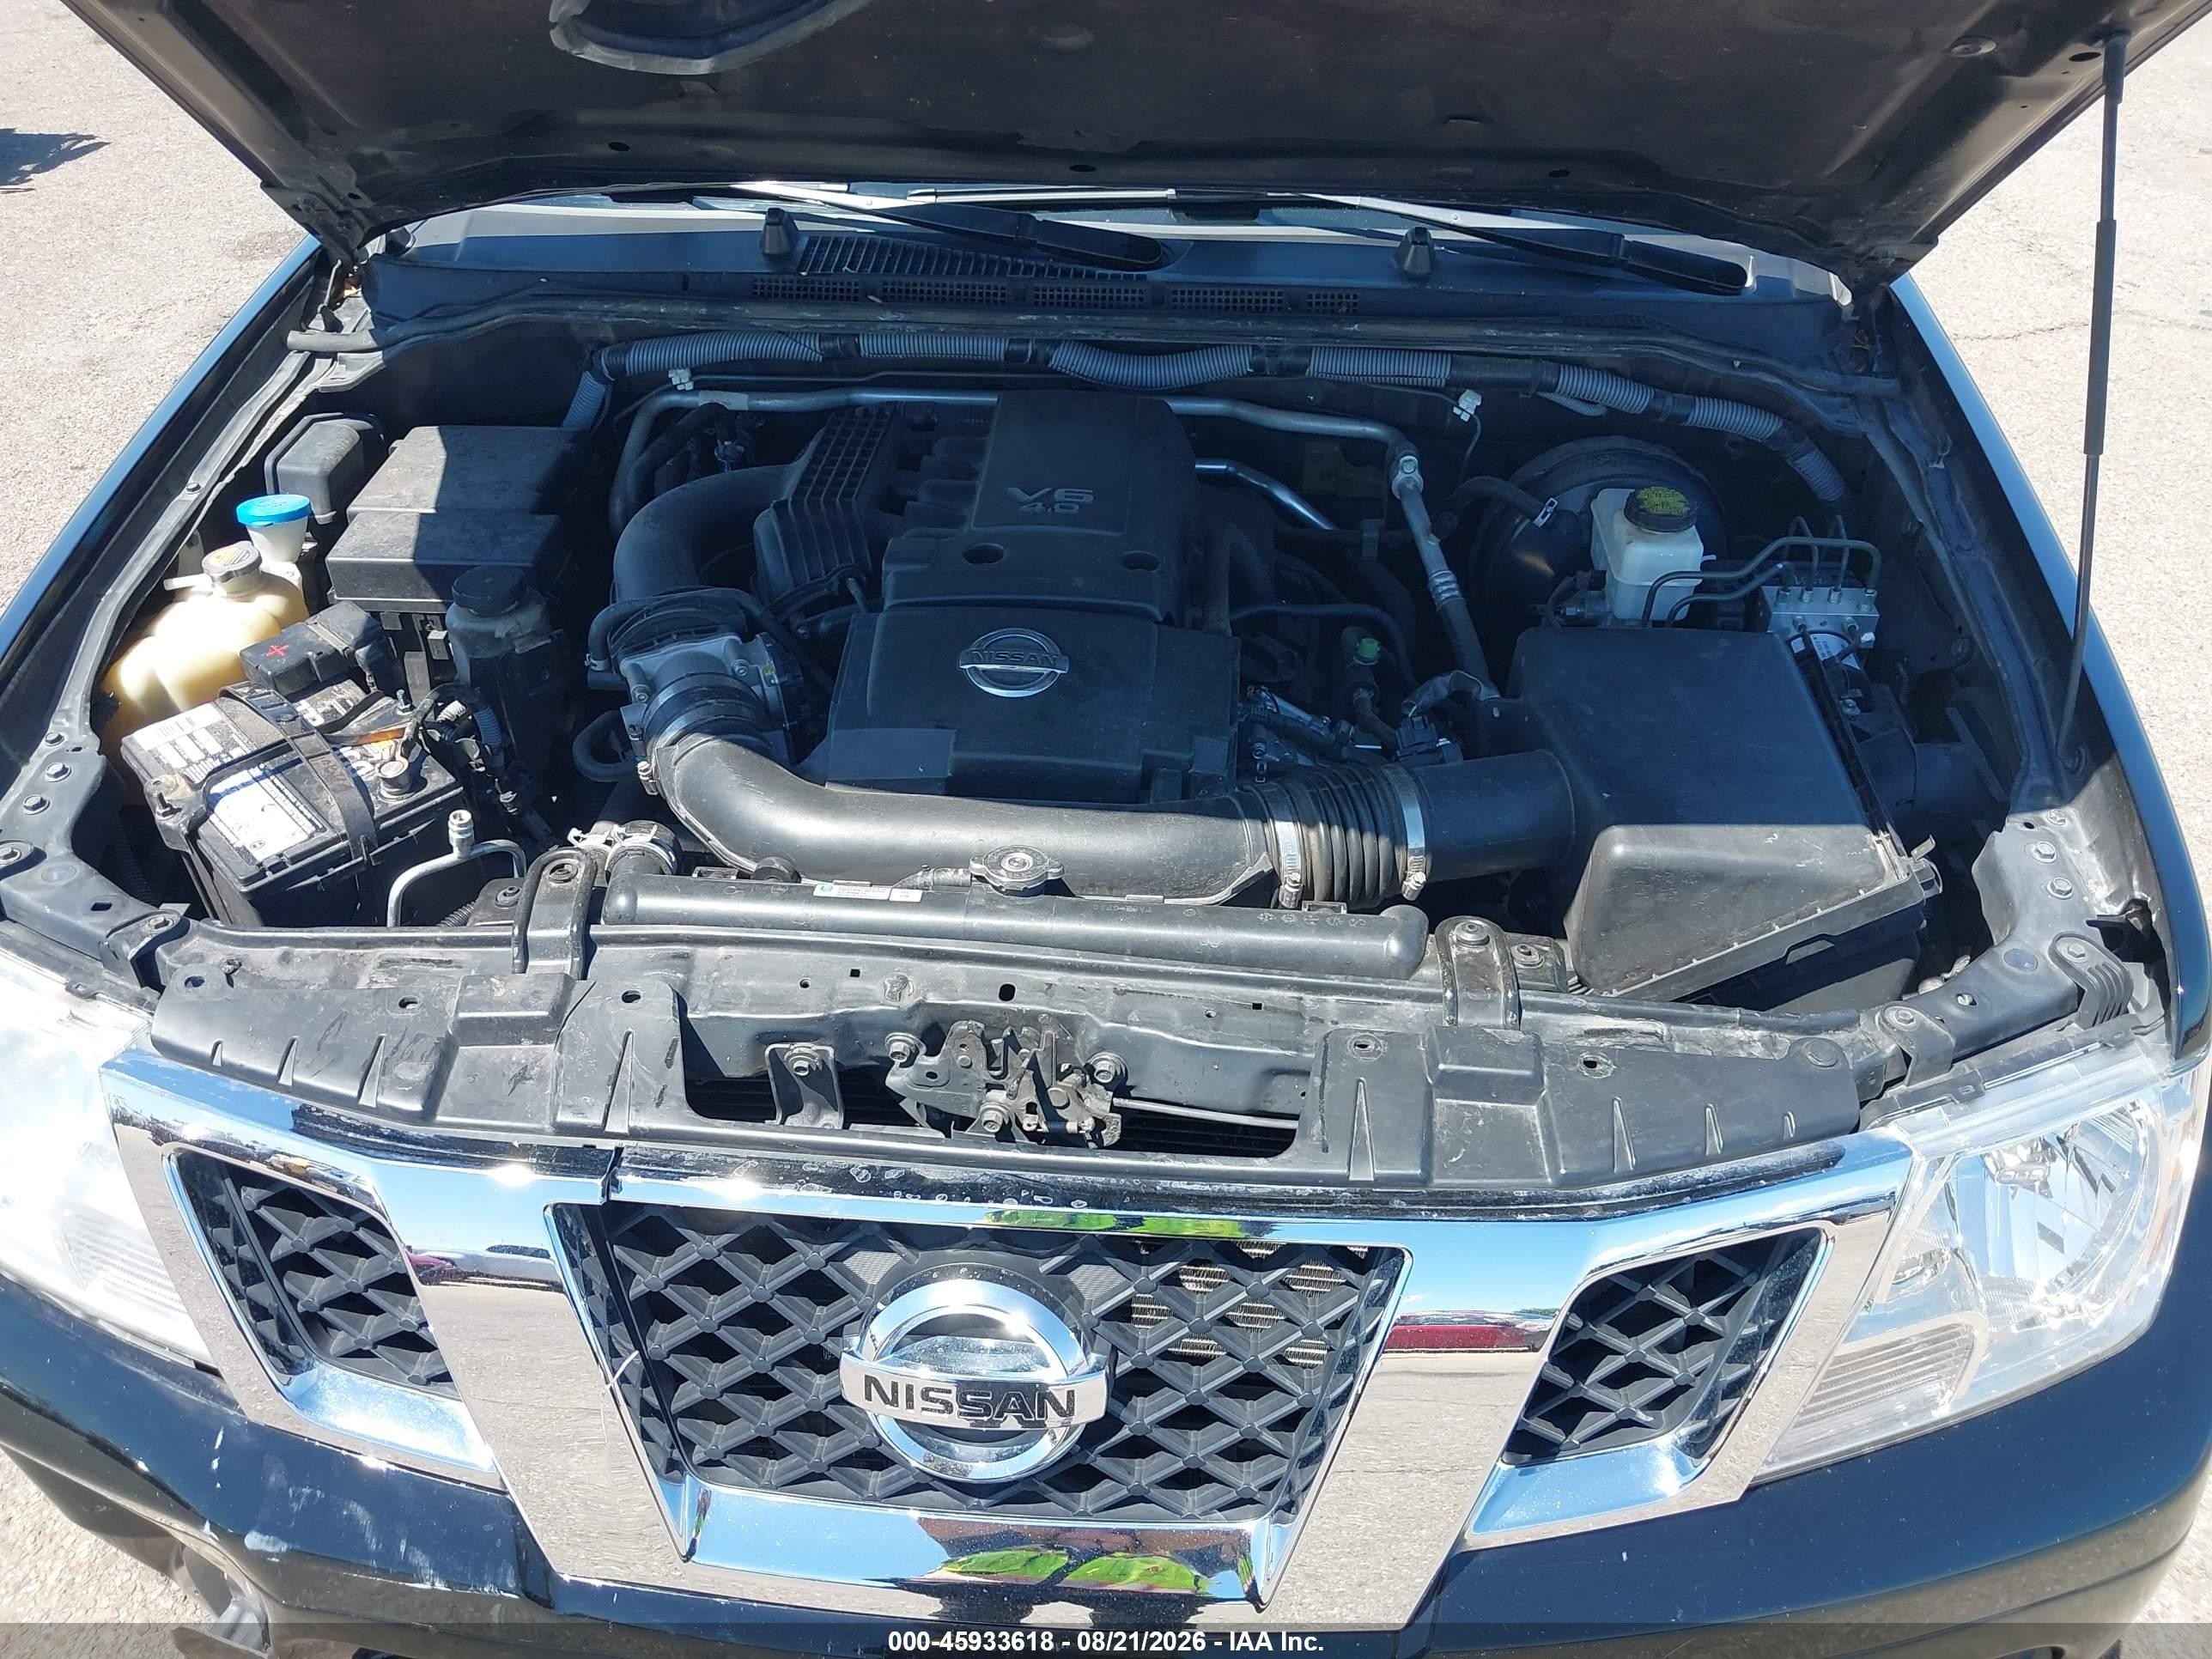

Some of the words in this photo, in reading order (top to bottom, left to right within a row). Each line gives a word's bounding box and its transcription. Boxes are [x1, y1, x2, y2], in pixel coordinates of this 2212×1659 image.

[1006, 487, 1094, 504] V6
[1018, 501, 1080, 515] 4.0
[970, 650, 1060, 666] NISSAN
[863, 1374, 1075, 1421] NISSAN
